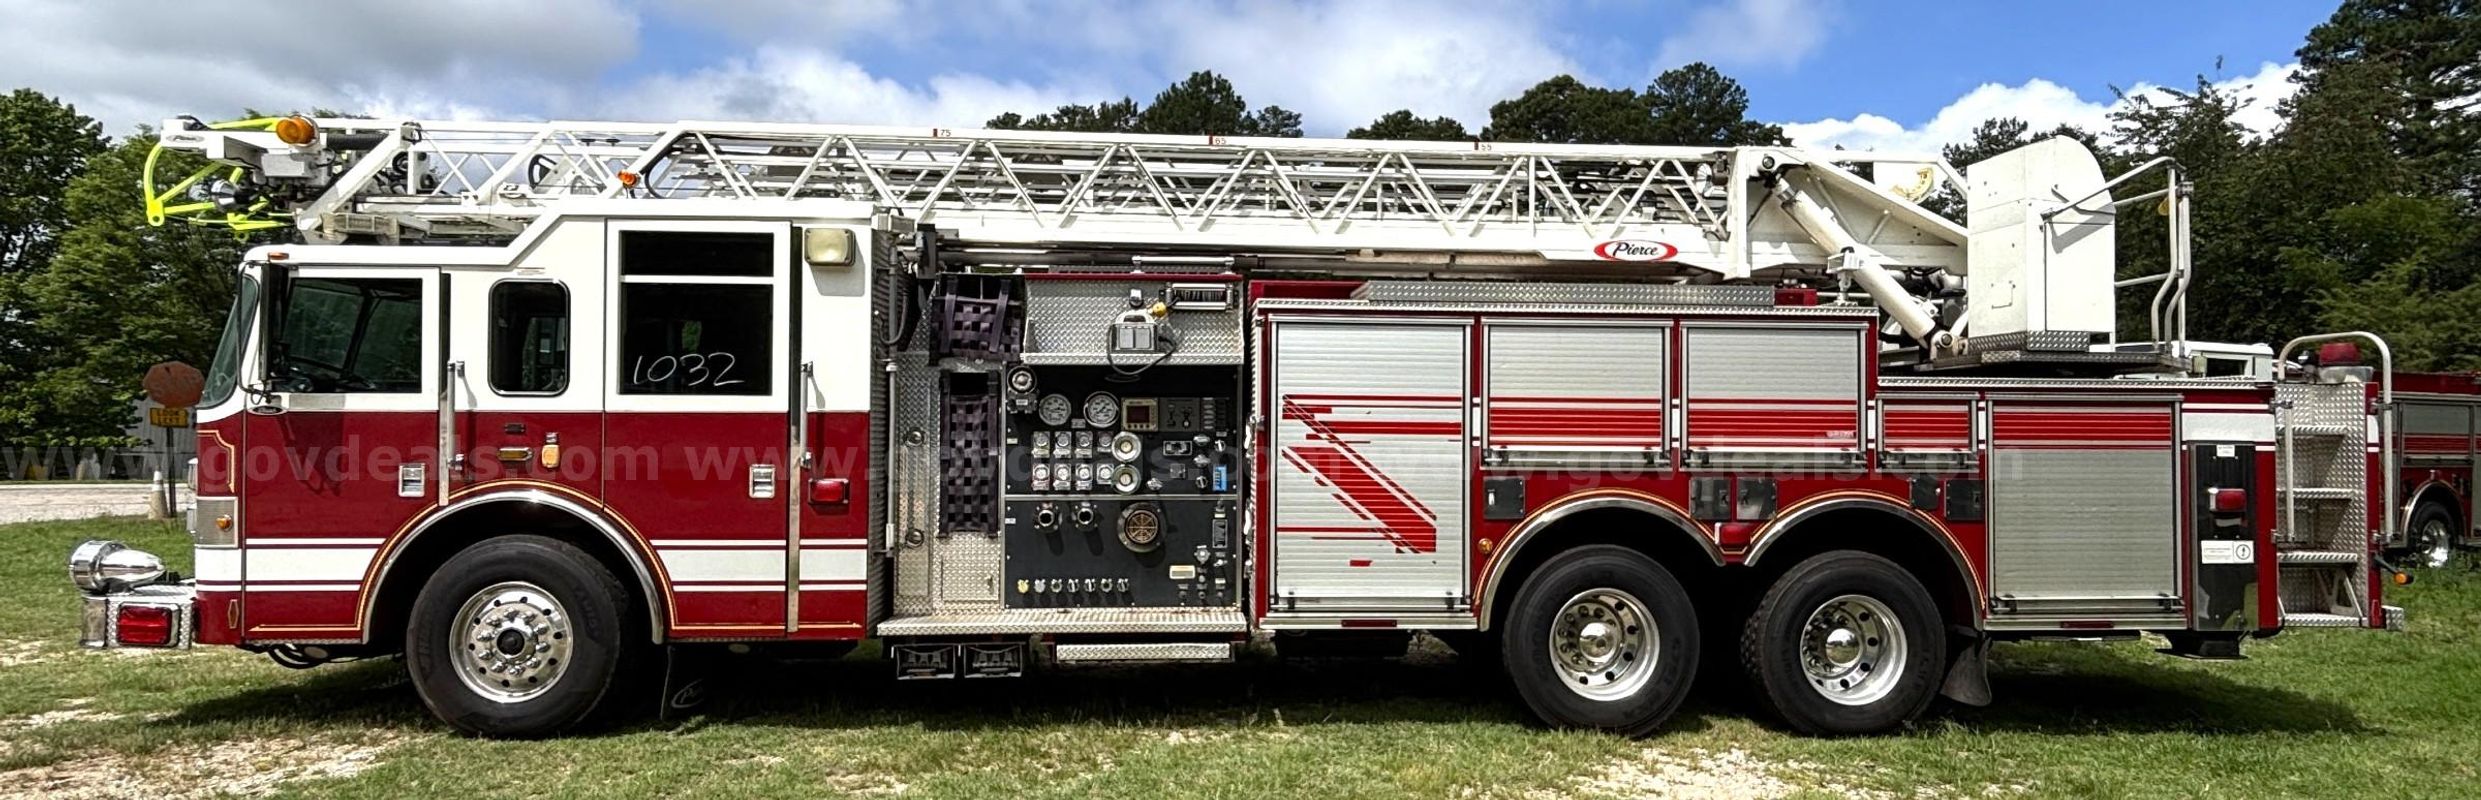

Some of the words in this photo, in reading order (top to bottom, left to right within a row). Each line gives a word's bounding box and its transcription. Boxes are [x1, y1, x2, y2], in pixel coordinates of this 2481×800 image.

[1215, 137, 1226, 145] 65
[1612, 241, 1659, 257] Pierce
[633, 352, 744, 386] 1032
